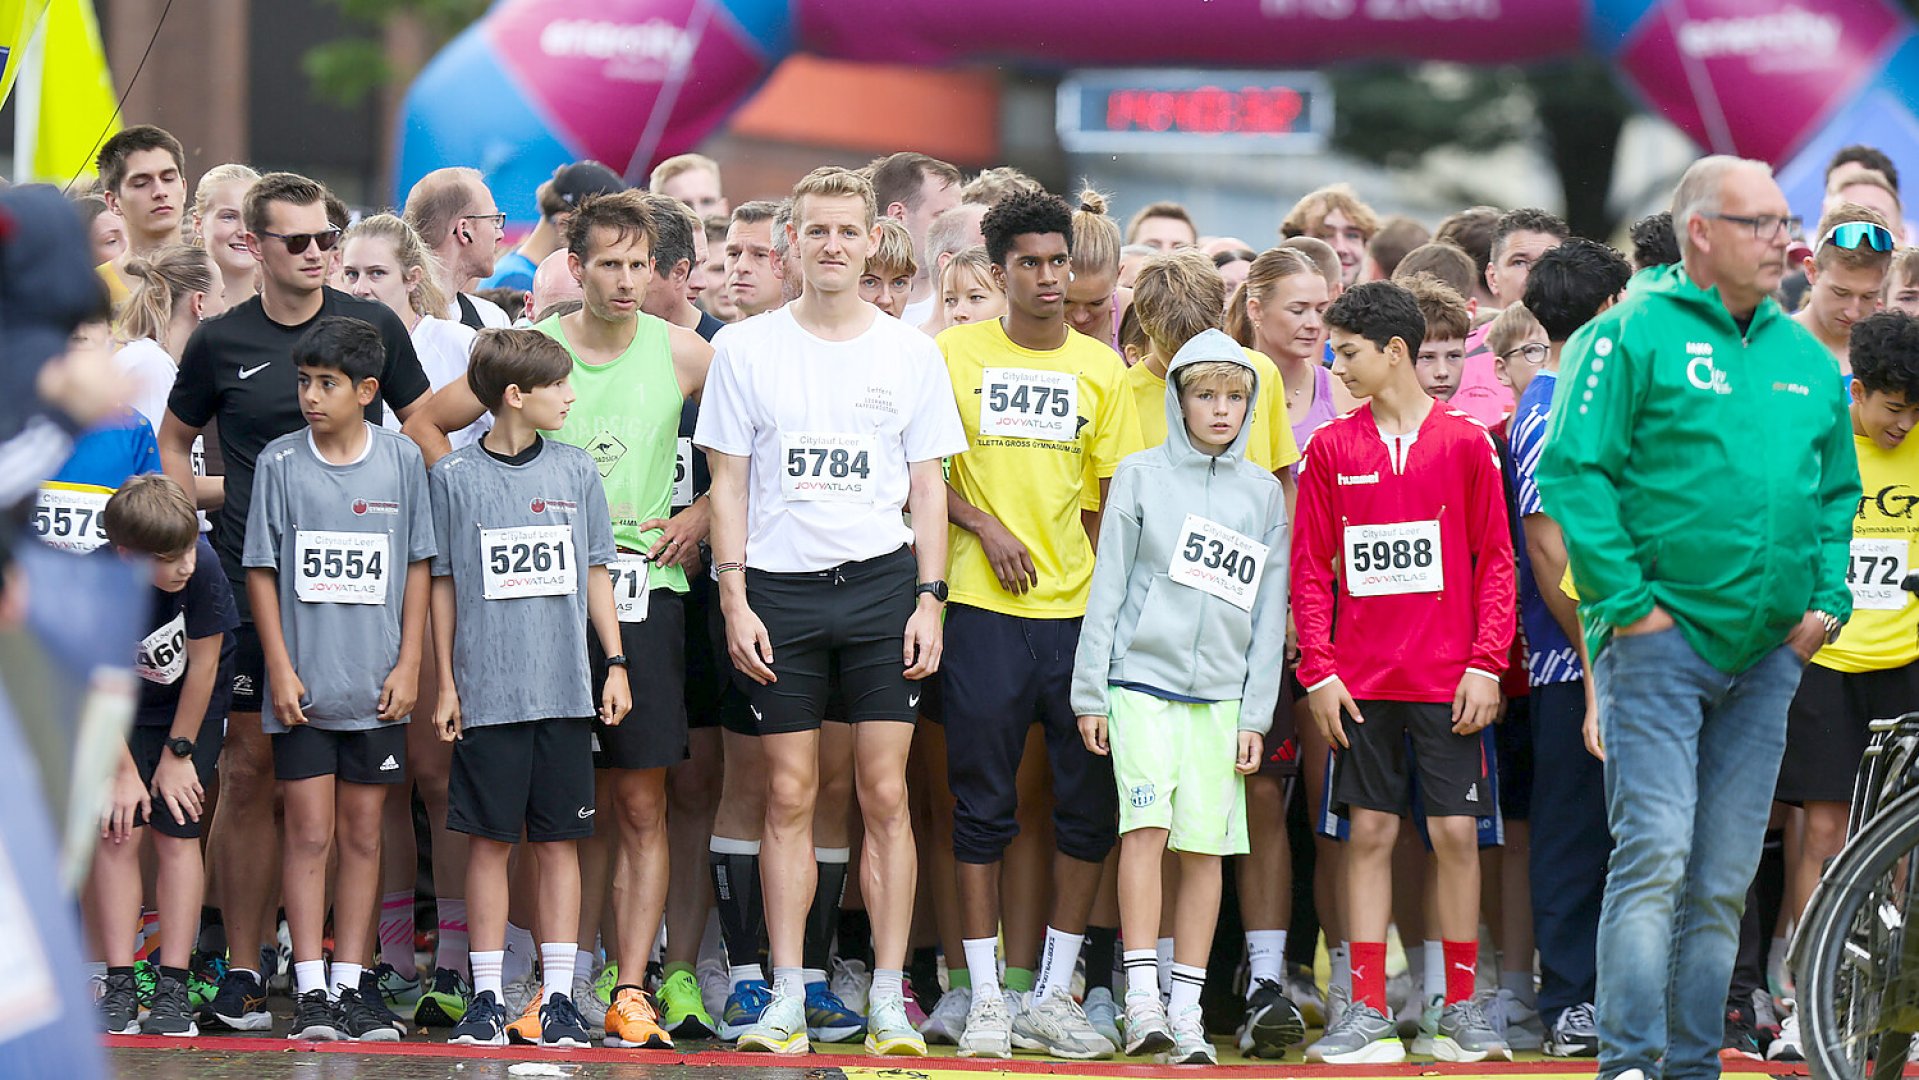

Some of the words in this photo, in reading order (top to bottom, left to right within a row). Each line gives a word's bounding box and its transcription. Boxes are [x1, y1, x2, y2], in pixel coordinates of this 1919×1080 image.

[1040, 375, 1060, 384] Leer
[989, 383, 1069, 417] 5475
[996, 418, 1062, 430] JOVYATLAS
[839, 438, 859, 446] Leer
[1005, 440, 1031, 448] GROSS
[787, 448, 870, 479] 5784
[1337, 471, 1379, 485] hummel
[795, 482, 862, 492] JOVYATLAS
[1399, 527, 1420, 536] Leer
[355, 538, 375, 546] Leer
[1235, 537, 1252, 550] Leer
[490, 541, 565, 574] 5261
[1183, 532, 1256, 584] 5340
[1353, 538, 1432, 572] 5988
[303, 548, 382, 580] 5554
[500, 576, 565, 588] JOVYATLAS
[1185, 568, 1244, 595] JOVYATLAS
[1362, 572, 1427, 584] JOVYATLAS
[309, 583, 376, 593] JOVYATLAS
